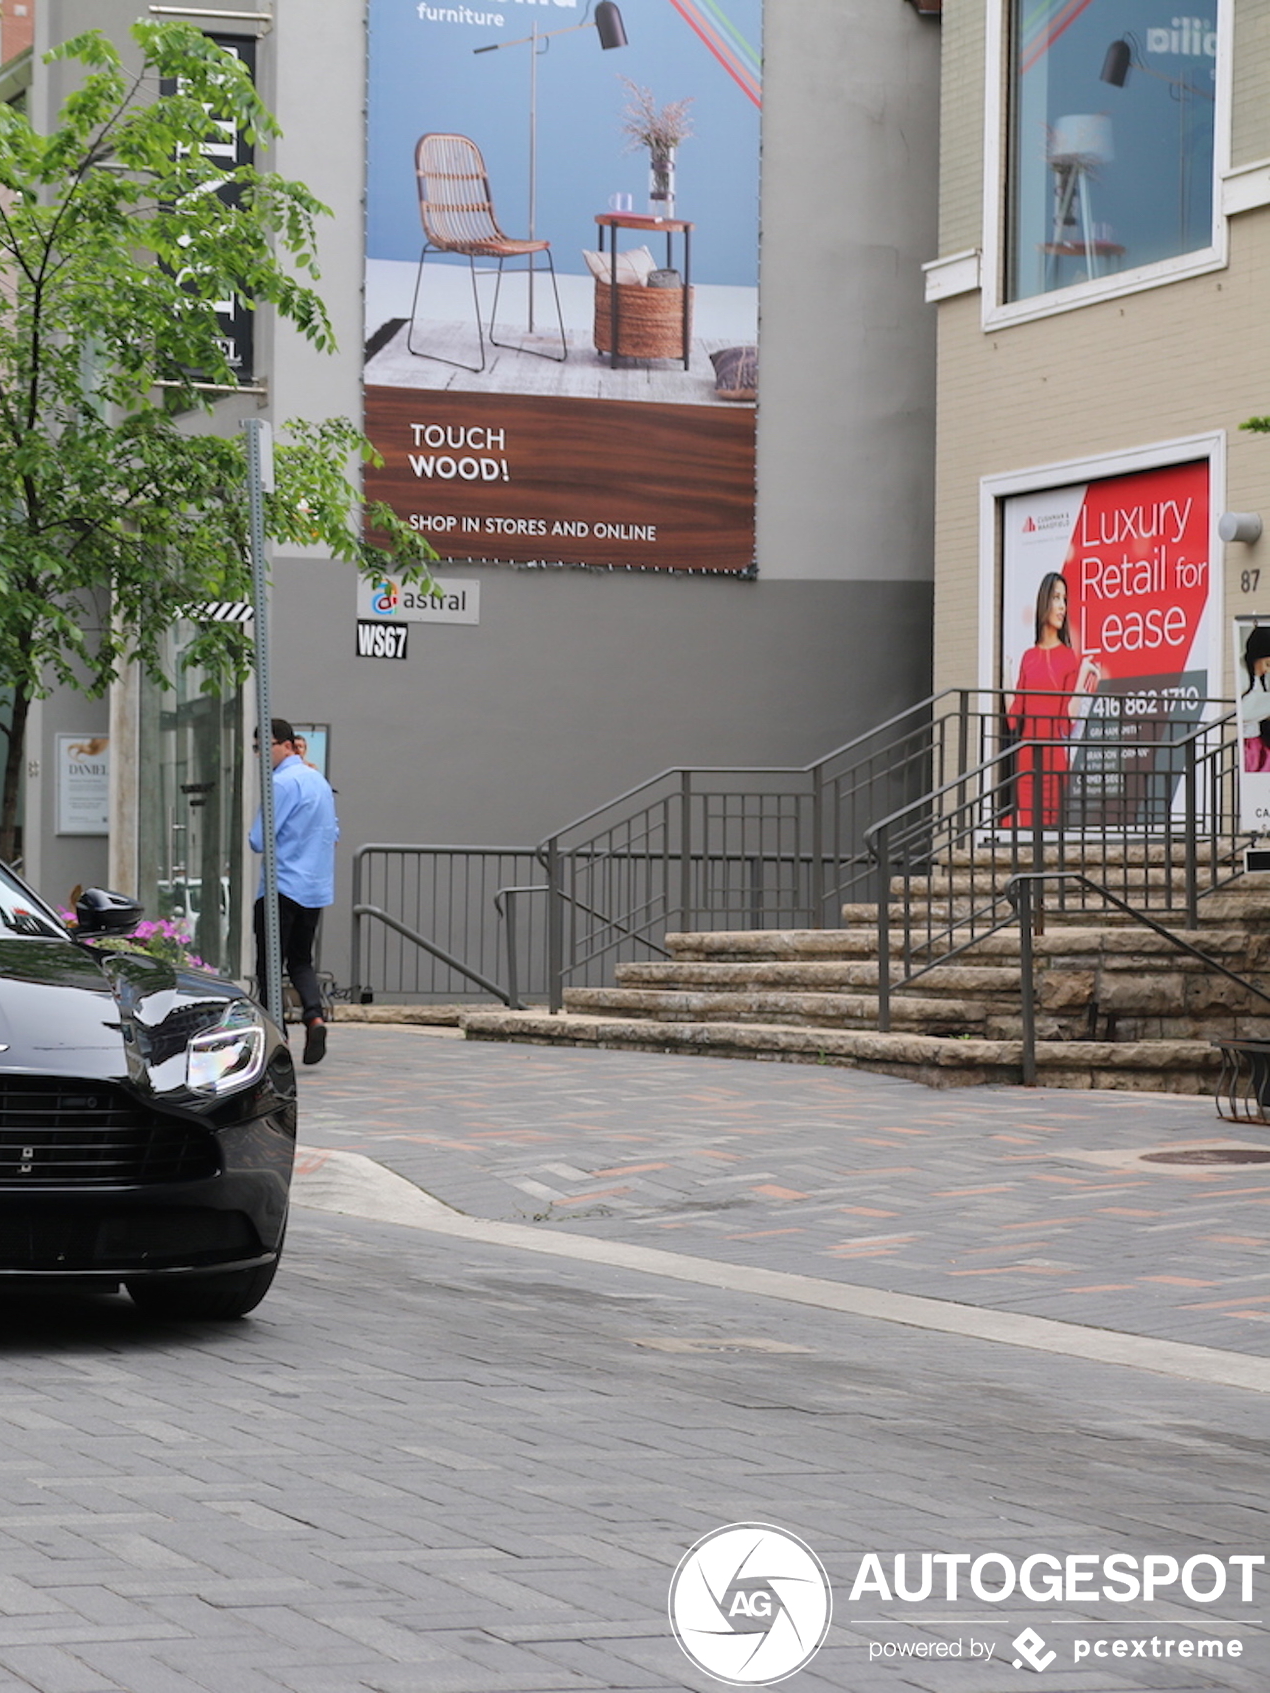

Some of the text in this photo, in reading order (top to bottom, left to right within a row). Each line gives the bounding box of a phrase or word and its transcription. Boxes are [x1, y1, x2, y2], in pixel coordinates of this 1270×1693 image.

[416, 3, 505, 27] furniture
[410, 423, 505, 450] TOUCH
[408, 454, 510, 482] WOOD!
[409, 514, 656, 541] SHOP IN STORES AND ONLINE
[1081, 497, 1192, 548] Luxury
[1081, 544, 1208, 602] Retail for
[1240, 569, 1261, 593] 87
[403, 590, 466, 611] astral
[358, 624, 407, 658] WS67
[1080, 605, 1187, 655] Lease
[1093, 696, 1120, 717] 416
[1162, 686, 1199, 712] 1710
[68, 764, 109, 775] DANIEL
